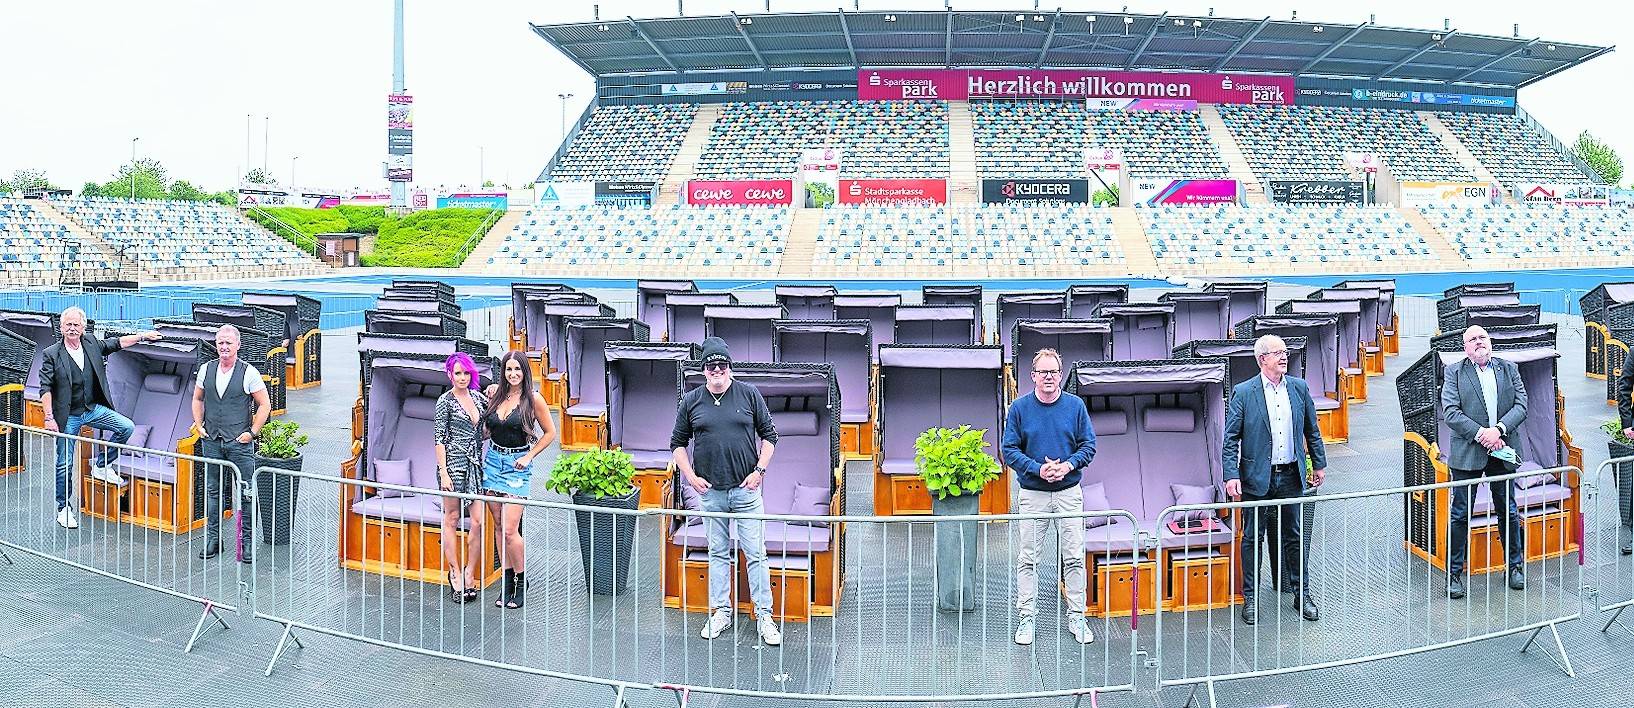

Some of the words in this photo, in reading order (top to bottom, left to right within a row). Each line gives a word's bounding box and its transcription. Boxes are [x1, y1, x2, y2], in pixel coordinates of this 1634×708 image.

[883, 78, 928, 87] Sparkassen
[902, 80, 938, 96] park
[968, 76, 1056, 95] Herzlich
[1062, 76, 1191, 97] willkommen
[1235, 82, 1276, 91] Sparkassen
[1252, 86, 1284, 102] park
[693, 188, 733, 200] cewe
[744, 188, 785, 200] cewe
[864, 187, 924, 196] Stadtsparkasse
[1016, 184, 1071, 195] KYOCERA
[1464, 187, 1486, 198] EGN
